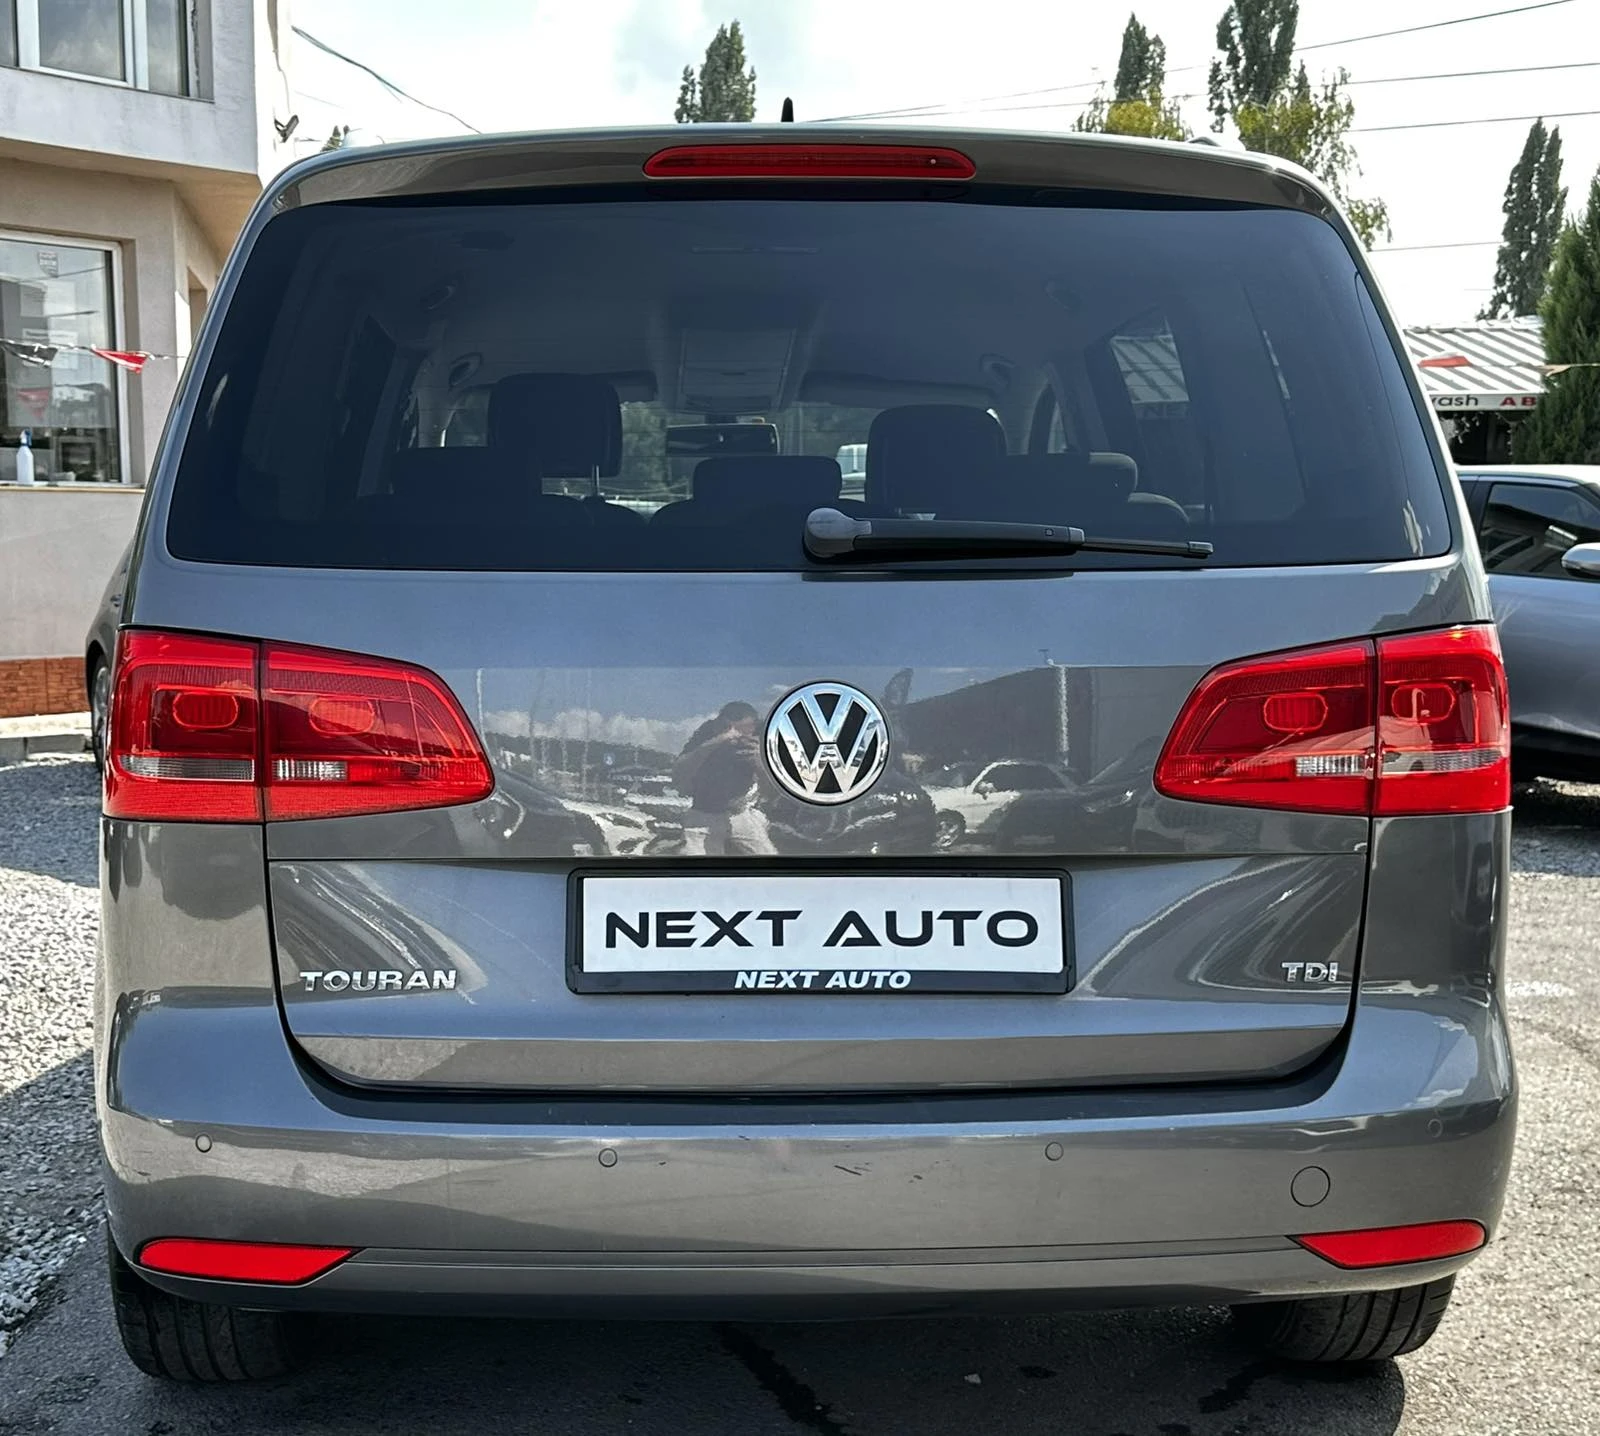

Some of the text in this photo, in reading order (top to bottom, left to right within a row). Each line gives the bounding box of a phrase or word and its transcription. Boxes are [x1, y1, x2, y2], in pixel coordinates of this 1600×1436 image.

[605, 910, 1039, 949] NEXT AUTO
[299, 969, 457, 993] TOURAN
[734, 970, 912, 989] NEXT AUTO
[1281, 961, 1339, 983] TDI
